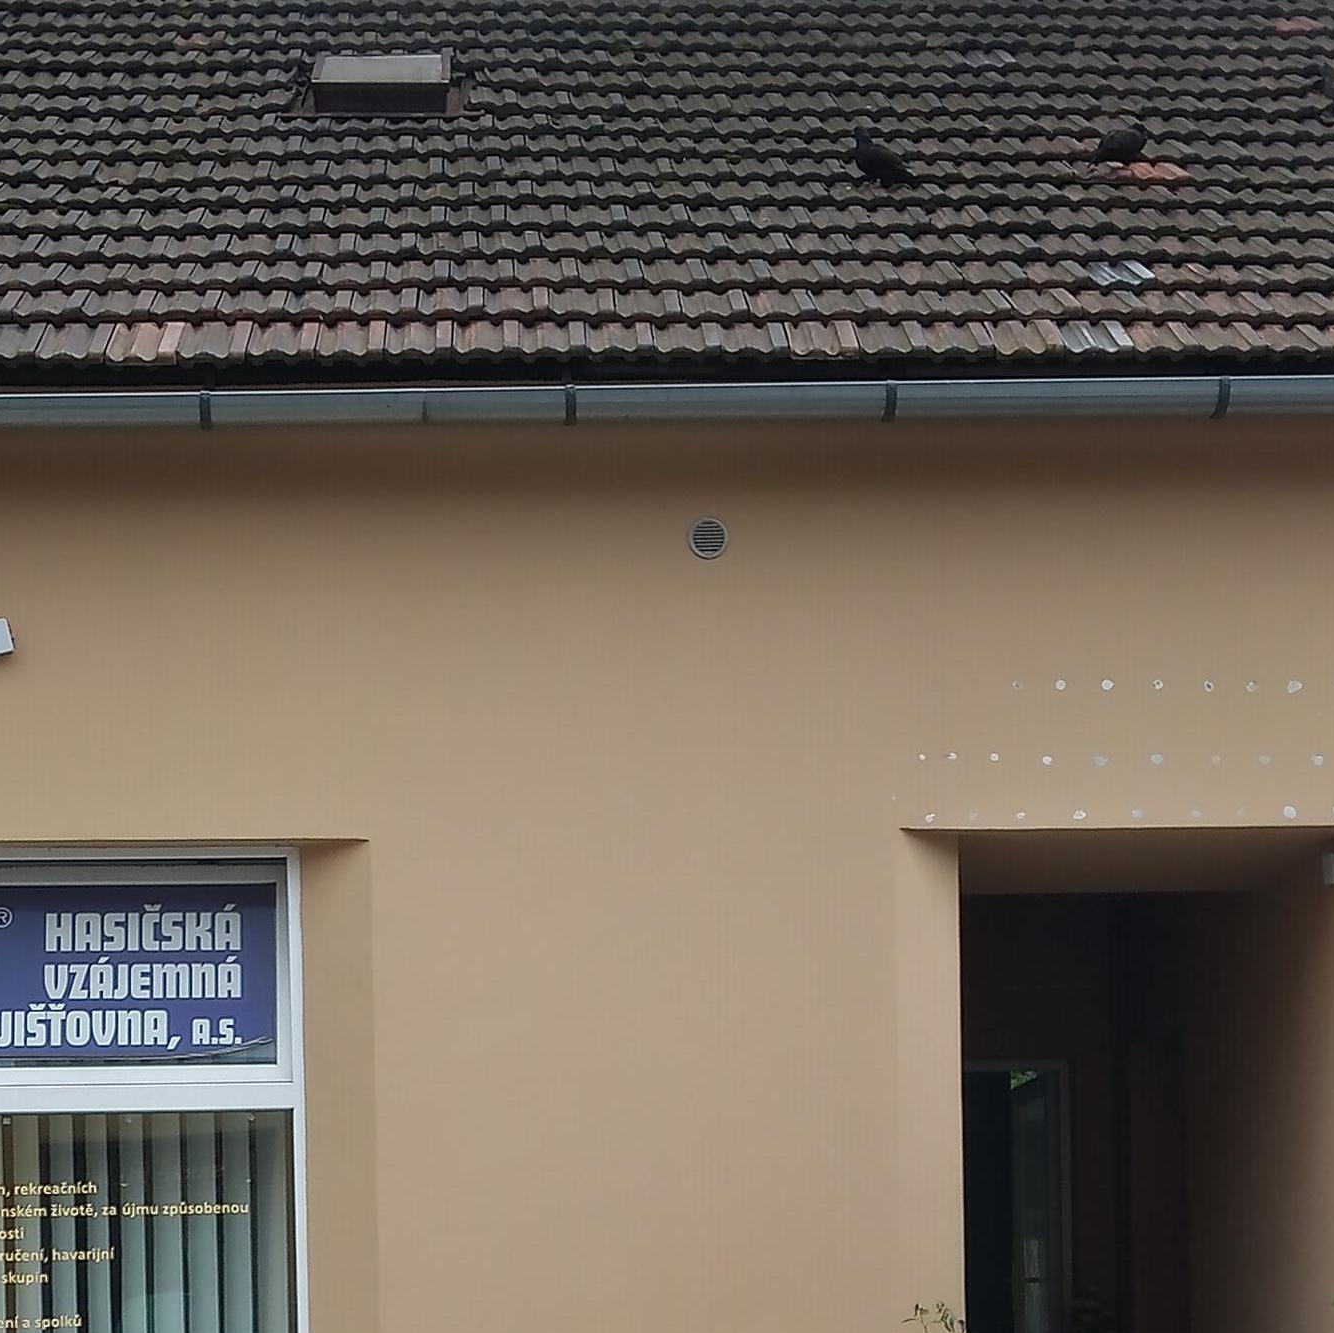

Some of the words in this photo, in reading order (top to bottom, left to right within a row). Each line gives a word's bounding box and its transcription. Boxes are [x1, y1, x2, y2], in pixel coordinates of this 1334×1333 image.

[45, 903, 242, 952] HASIČSKÁ
[44, 955, 242, 1000] VZÁJEMNÁ
[14, 1181, 97, 1196] rekreačních
[50, 1203, 98, 1218] životě,
[101, 1206, 117, 1216] za
[122, 1203, 159, 1218] újmu
[162, 1201, 249, 1218] způsobenou
[0, 1248, 49, 1263] ručení,
[52, 1247, 115, 1263] havarijní
[1, 1272, 48, 1287] skupin
[22, 1320, 30, 1329] a
[35, 1314, 82, 1331] spolků
